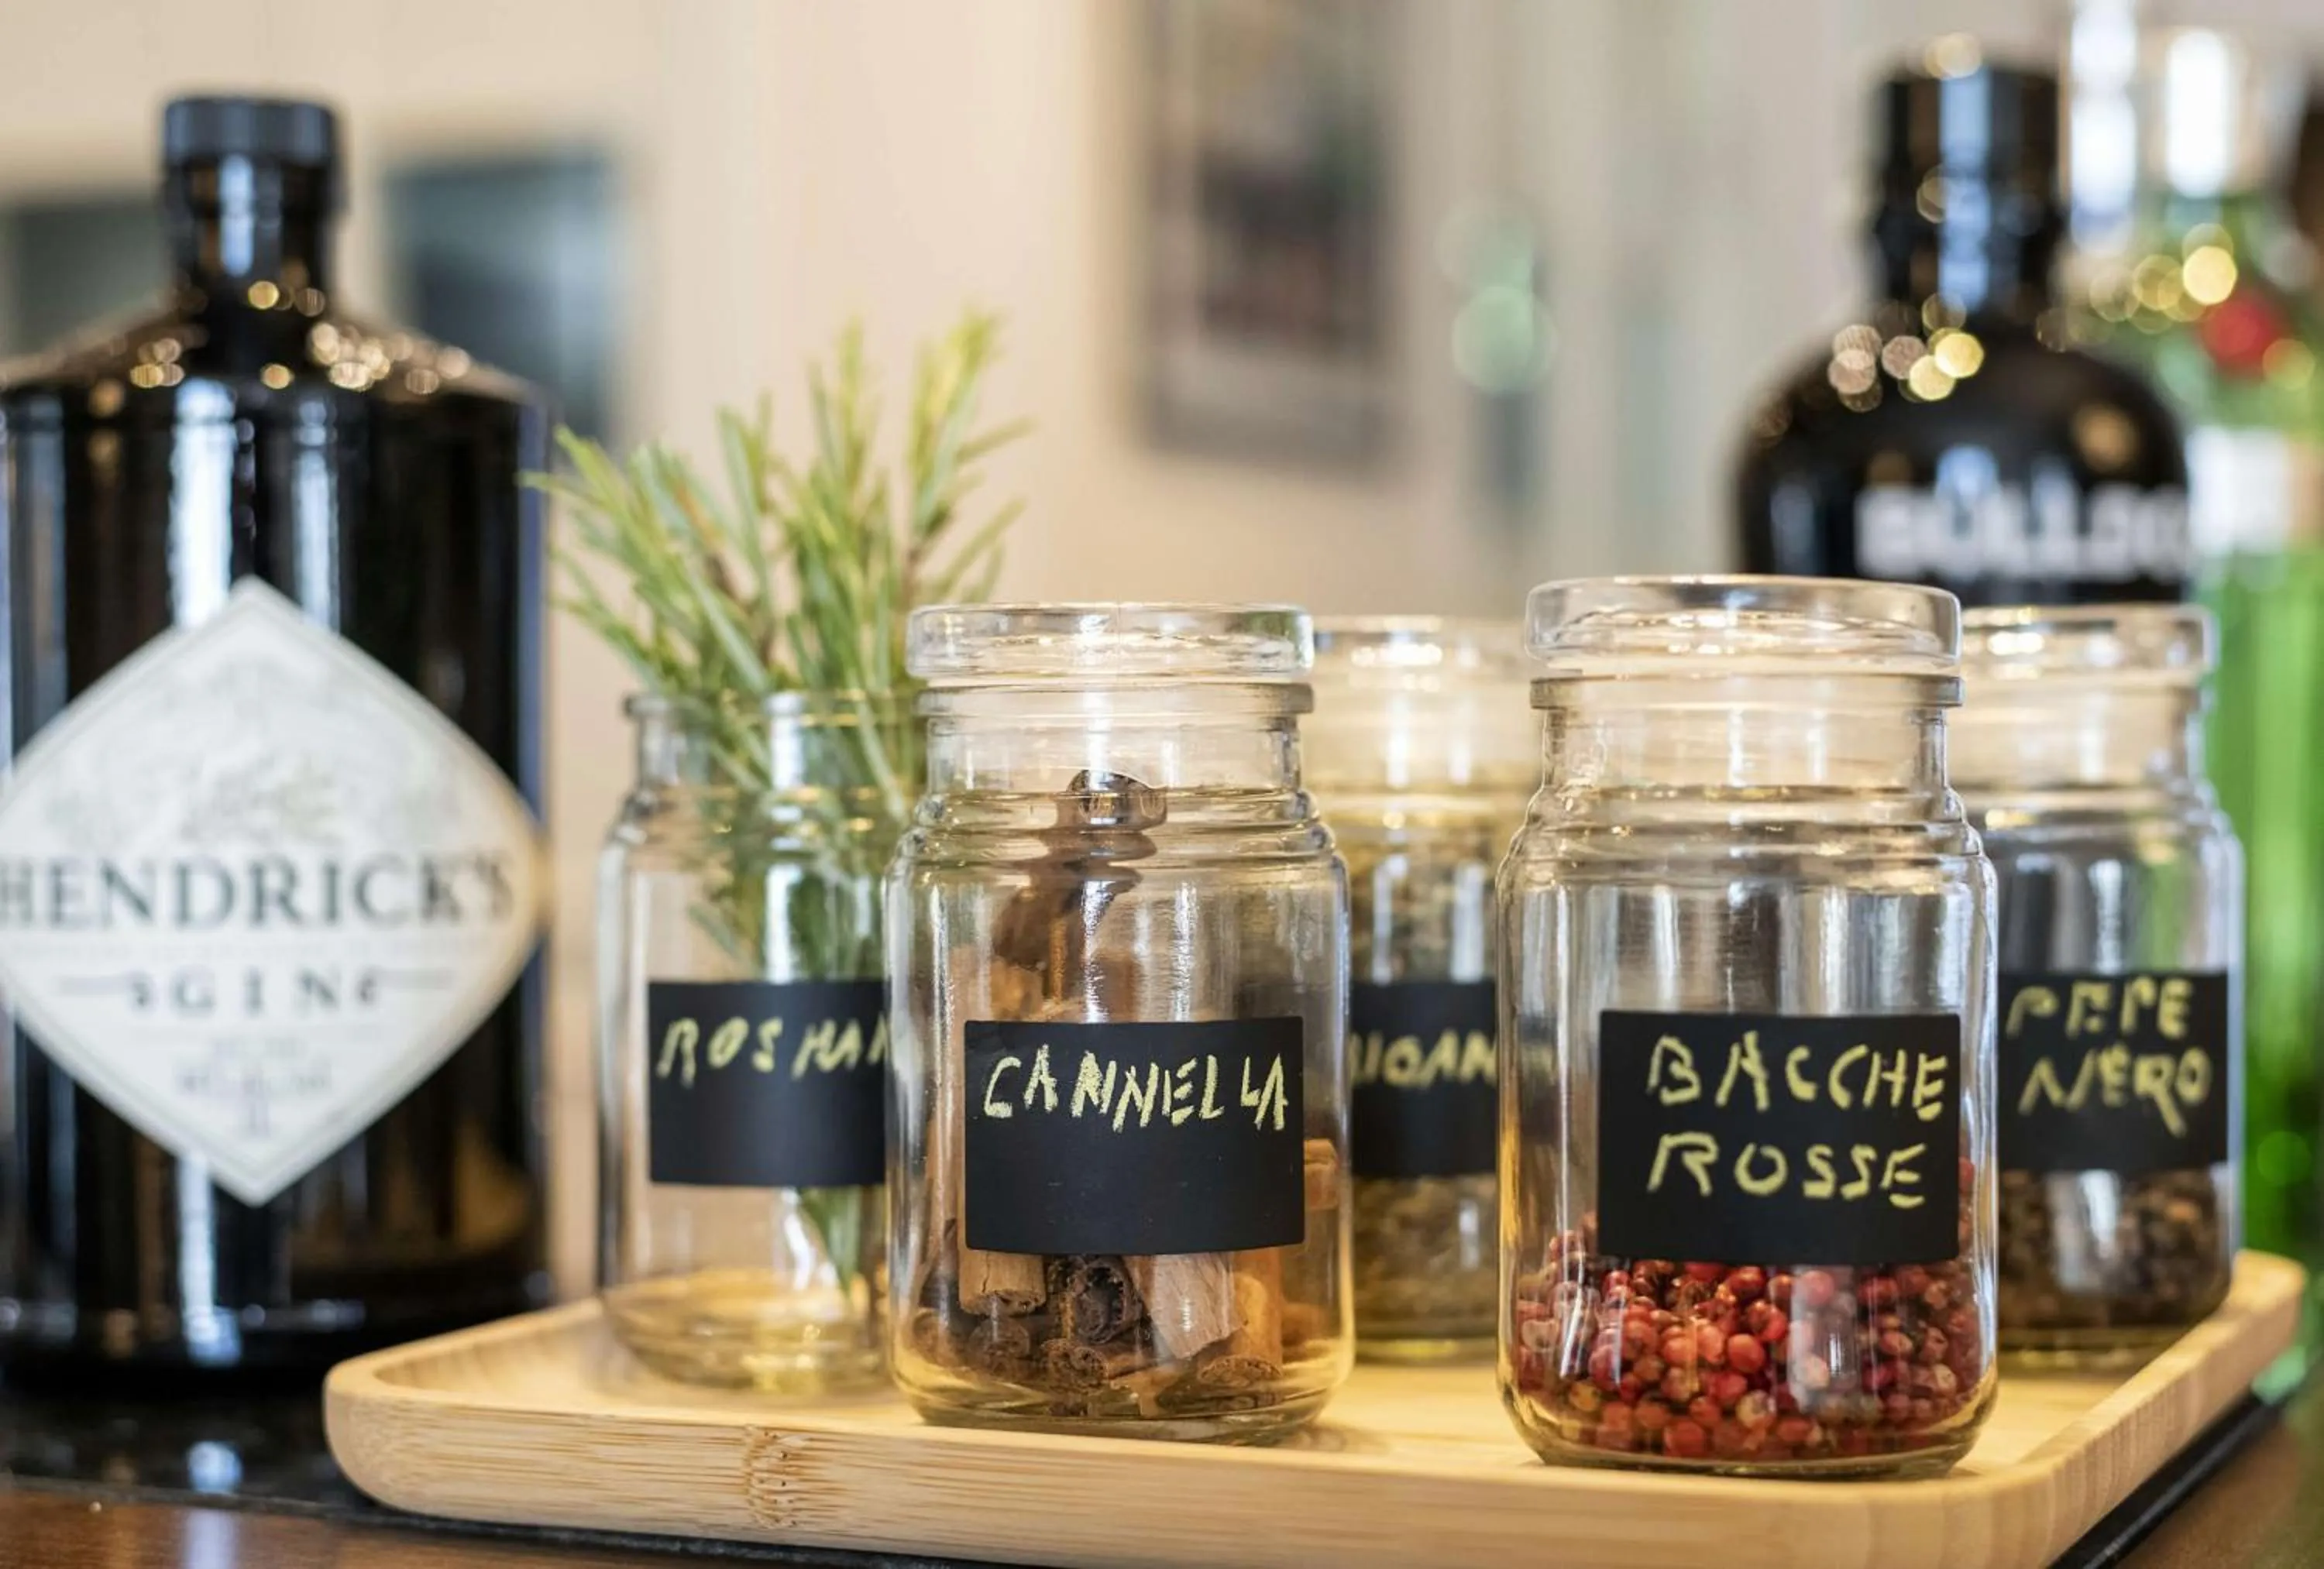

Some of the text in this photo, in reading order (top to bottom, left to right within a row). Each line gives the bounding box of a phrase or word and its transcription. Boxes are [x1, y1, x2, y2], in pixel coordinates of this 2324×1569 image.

[169, 965, 342, 1018] GIN
[2006, 975, 2192, 1039] PEPE
[984, 1044, 1289, 1132] CANNELLA
[1647, 1032, 1949, 1121] BACCHE
[2018, 1043, 2211, 1138] NERO
[1647, 1131, 1927, 1208] ROSSE
